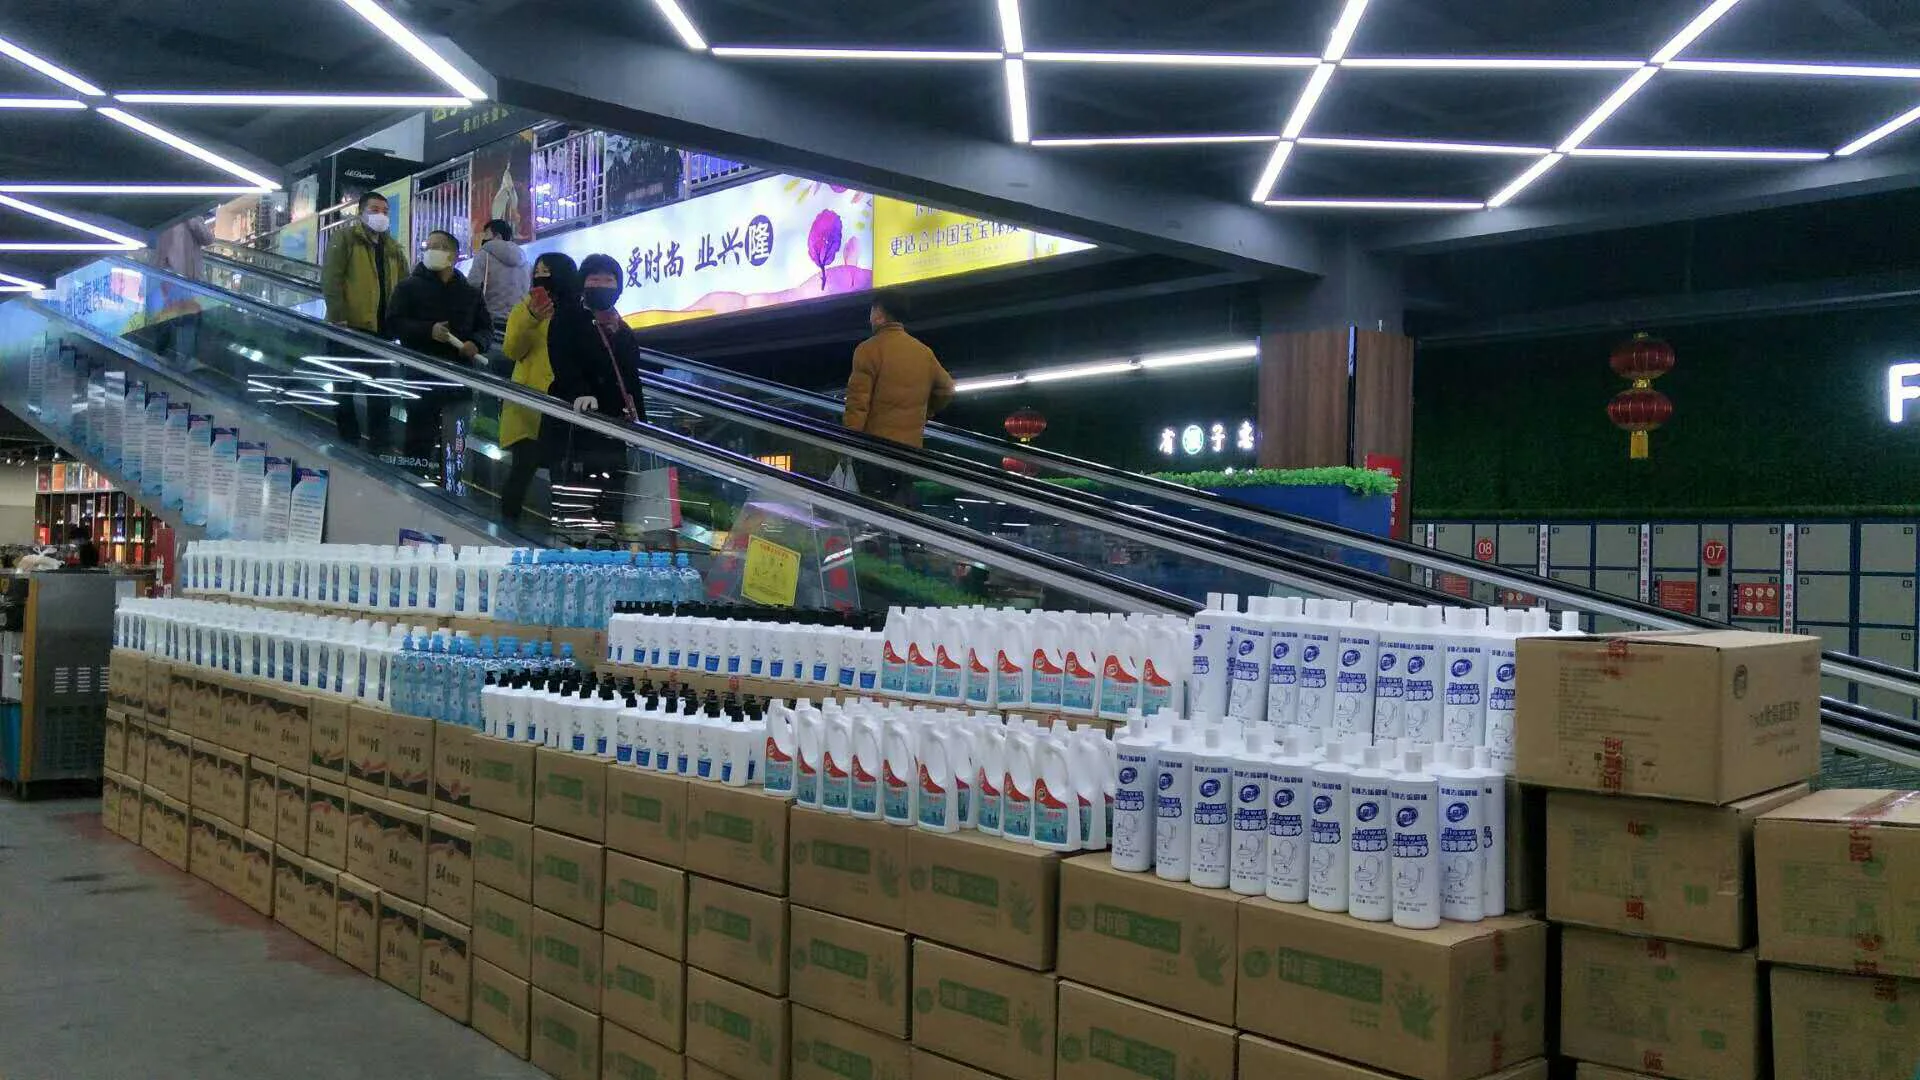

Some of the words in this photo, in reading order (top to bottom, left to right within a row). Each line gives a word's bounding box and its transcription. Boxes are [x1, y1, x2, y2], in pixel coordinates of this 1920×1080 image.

[626, 242, 684, 288] 爱时尚
[695, 215, 773, 272] 业兴隆
[1479, 543, 1492, 554] 08
[1706, 545, 1723, 559] 07
[1354, 827, 1386, 835] Flower
[1445, 827, 1476, 835] Flower
[1395, 833, 1427, 841] Flower
